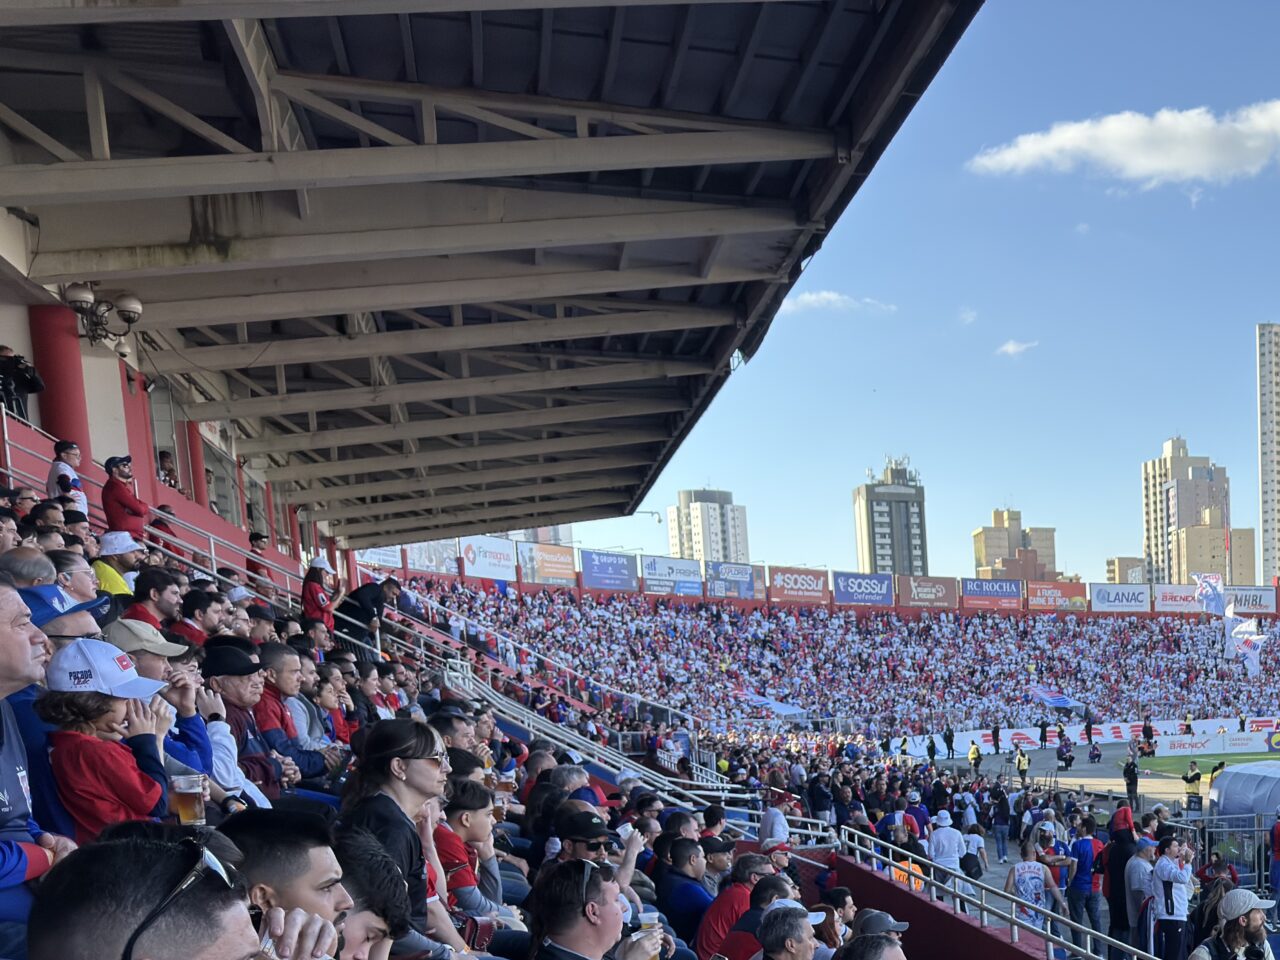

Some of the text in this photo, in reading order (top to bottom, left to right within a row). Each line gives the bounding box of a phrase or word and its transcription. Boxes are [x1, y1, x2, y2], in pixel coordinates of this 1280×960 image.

[784, 573, 823, 591] SOSSul
[848, 578, 888, 595] SOSSul
[967, 581, 1016, 593] RC ROCHA
[853, 592, 883, 601] Defender
[1107, 591, 1145, 604] LANAC
[1162, 595, 1196, 603] BRENEX
[1169, 739, 1210, 750] BRENEX
